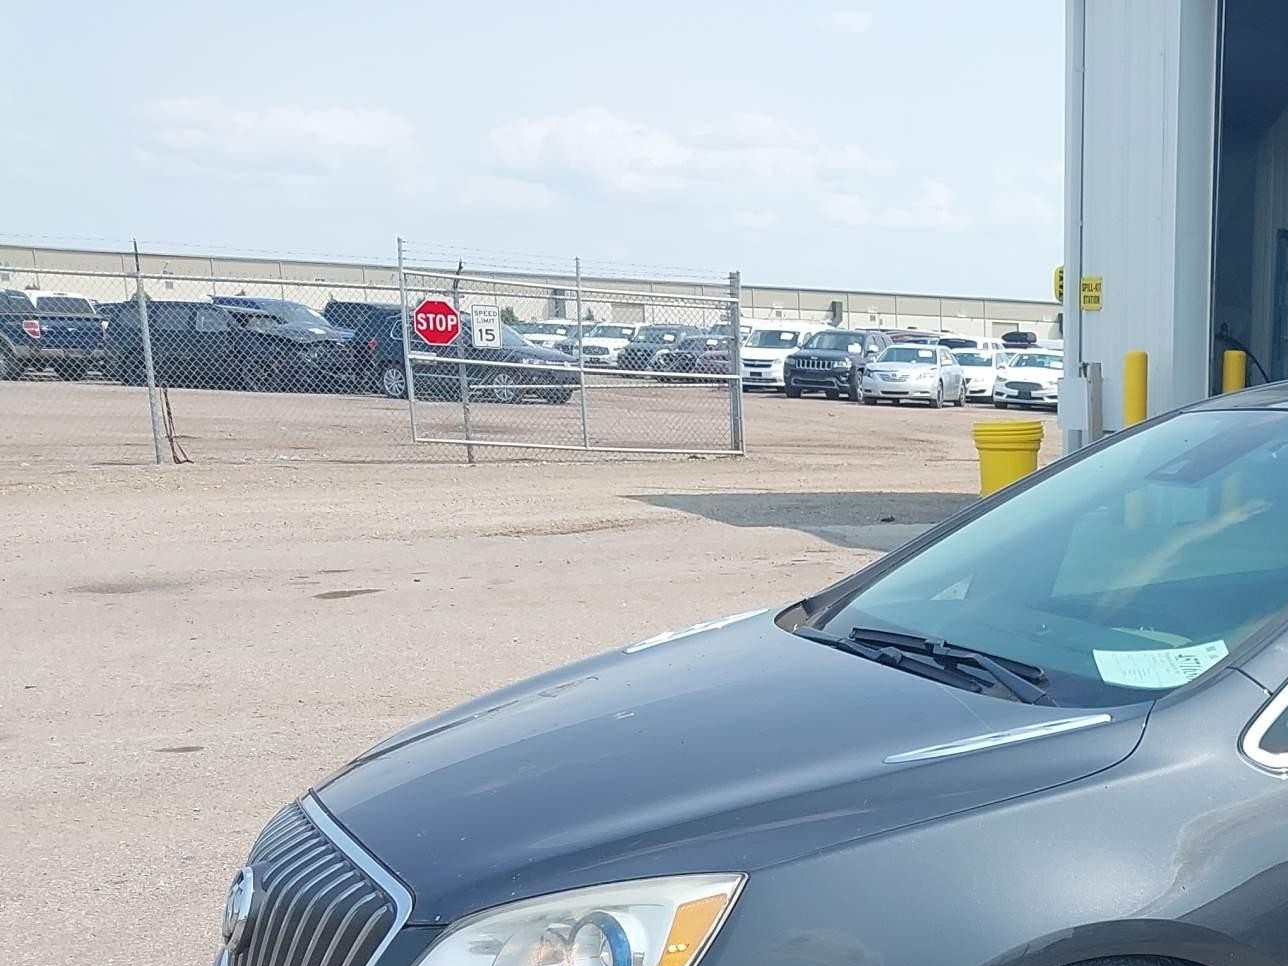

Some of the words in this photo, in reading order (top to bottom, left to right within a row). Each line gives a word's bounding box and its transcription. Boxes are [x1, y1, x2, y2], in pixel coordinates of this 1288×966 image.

[474, 310, 498, 318] SPEED
[417, 313, 457, 332] STOP
[478, 328, 496, 343] 15
